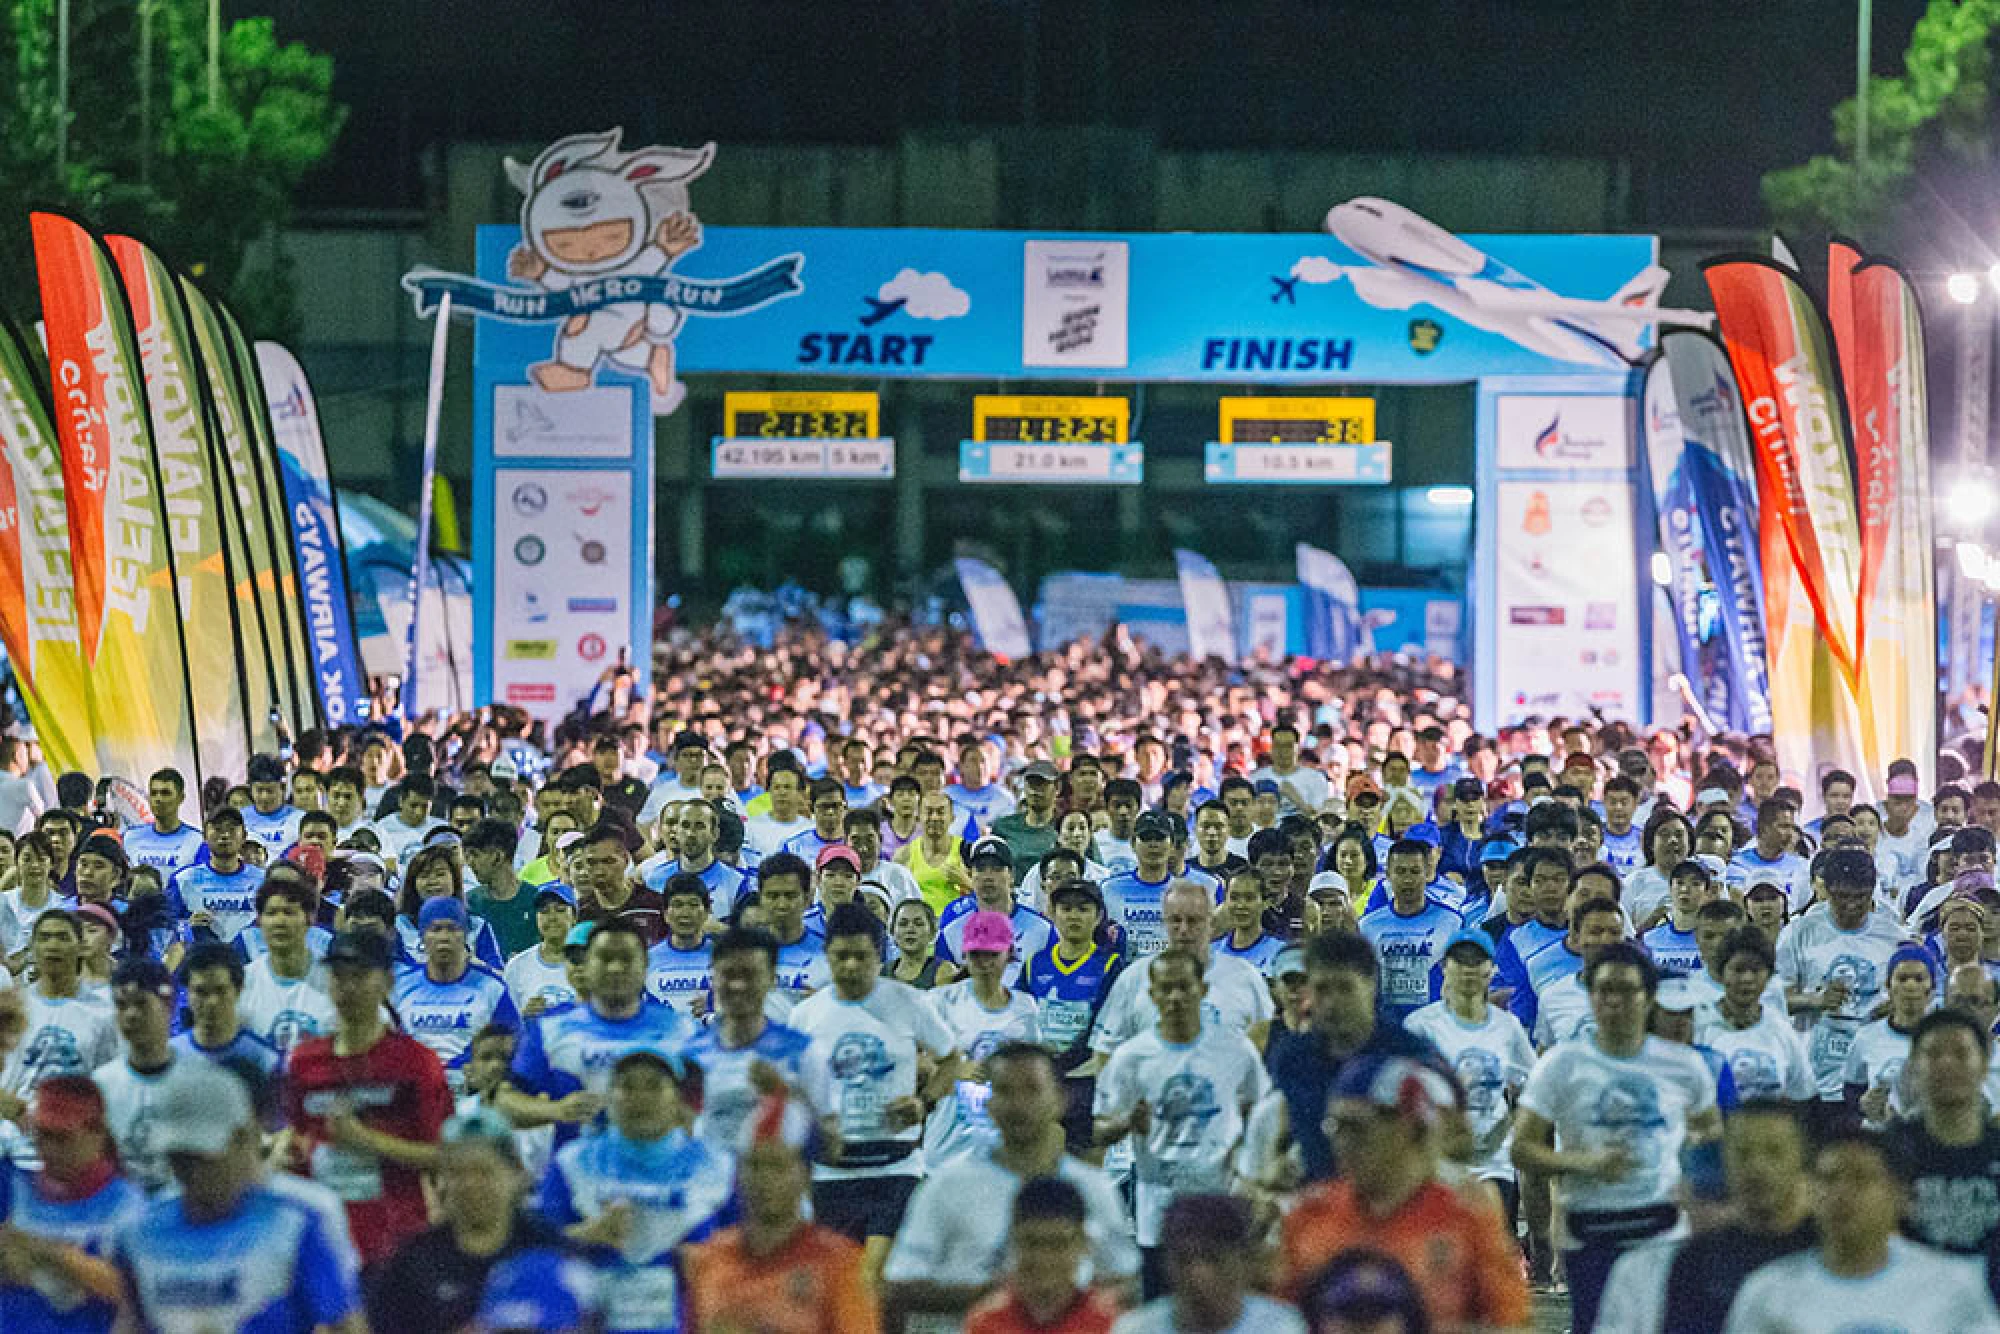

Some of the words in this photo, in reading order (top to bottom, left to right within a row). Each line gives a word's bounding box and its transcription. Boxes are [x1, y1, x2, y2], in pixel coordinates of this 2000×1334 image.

[494, 290, 547, 315] RUN
[570, 280, 642, 307] HERO
[663, 280, 723, 305] RUN
[797, 332, 934, 365] START
[1202, 336, 1355, 371] FINISH
[720, 448, 785, 465] 42.195
[790, 447, 820, 464] km
[831, 448, 845, 465] 5
[849, 448, 880, 464] km
[1014, 452, 1056, 468] 21.0
[1059, 454, 1089, 468] km
[1304, 455, 1333, 470] km
